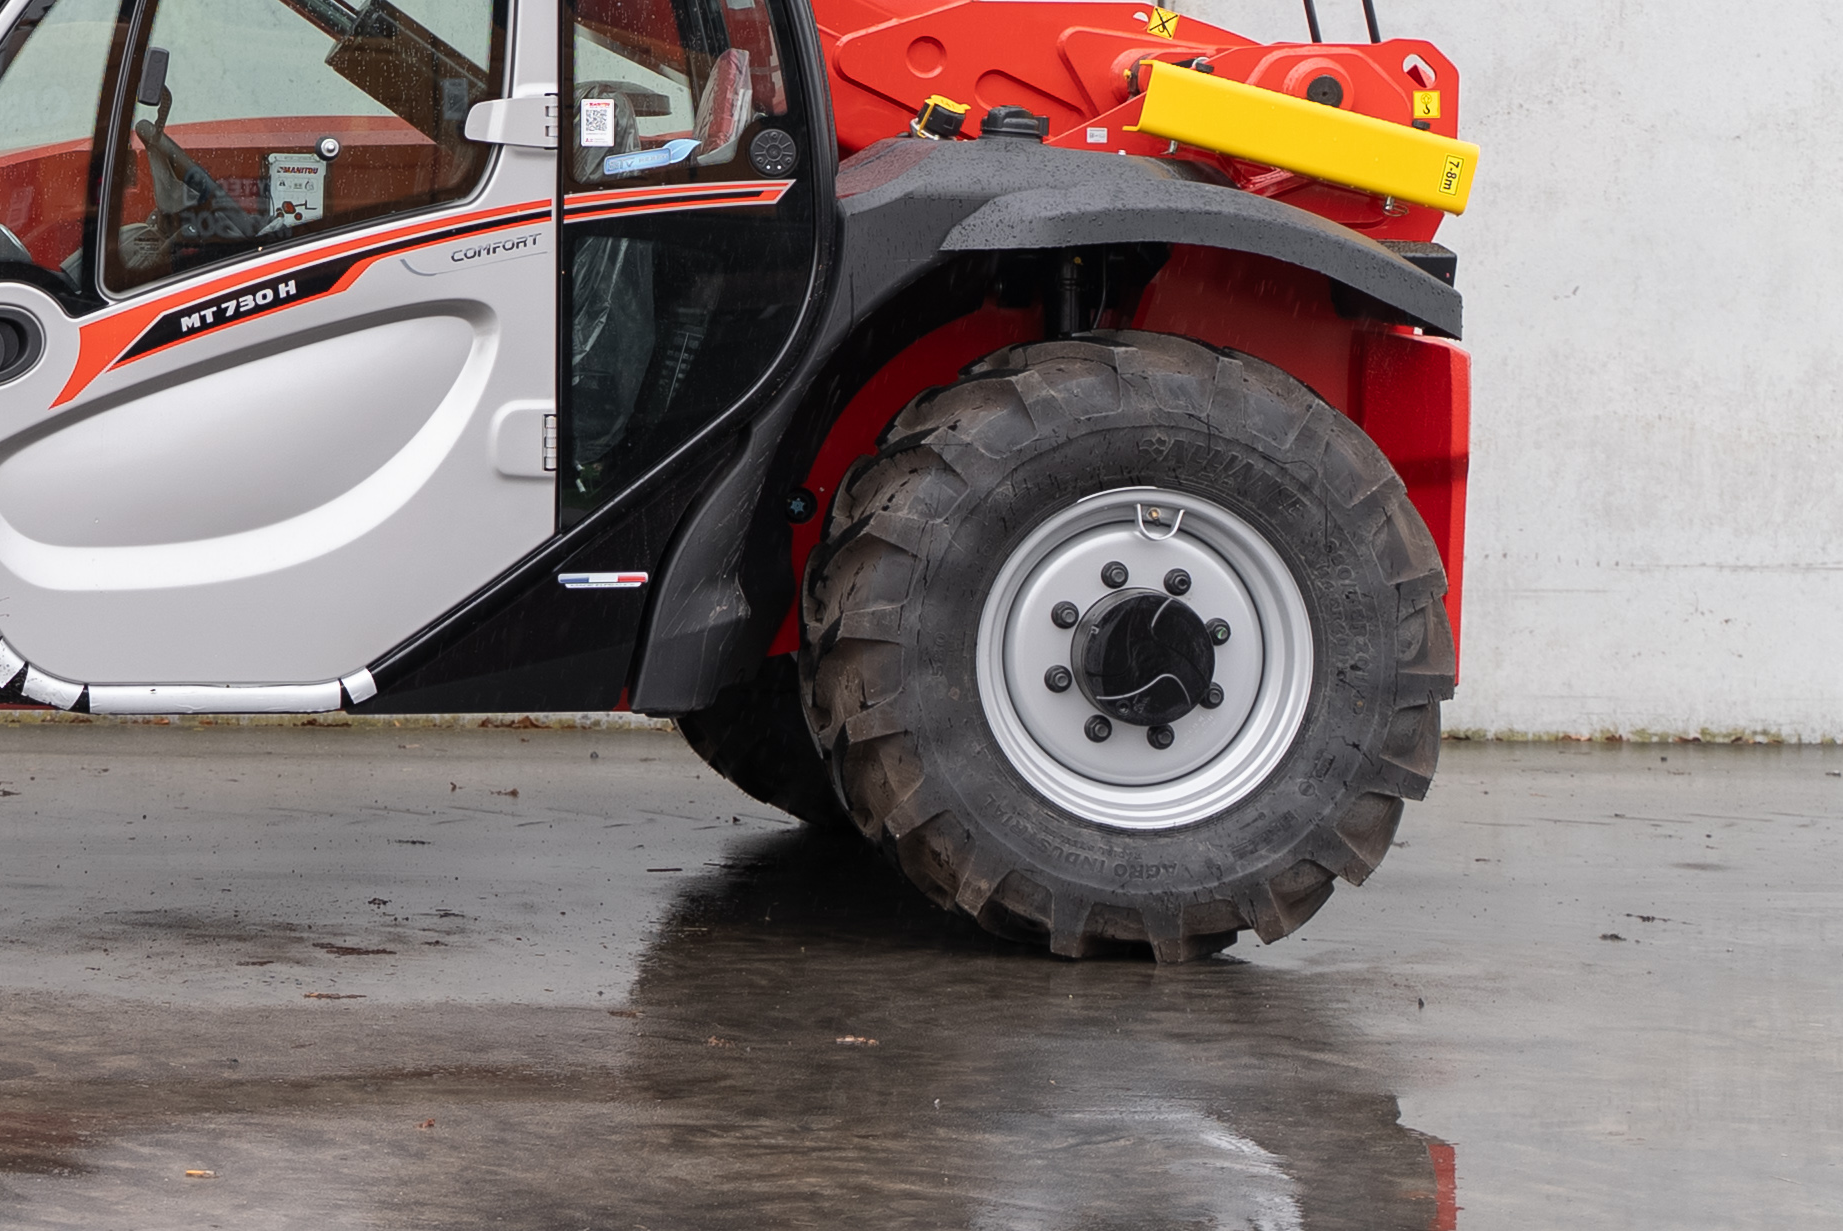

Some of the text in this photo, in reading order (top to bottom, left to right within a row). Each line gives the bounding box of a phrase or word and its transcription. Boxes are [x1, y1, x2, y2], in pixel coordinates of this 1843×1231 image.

[1443, 161, 1460, 190] 7-8m
[450, 232, 542, 262] COMFORT
[180, 279, 297, 333] MT 730 H
[1159, 436, 1308, 517] ALLIANCE
[977, 791, 1179, 878] AGRO INDUSTRIAL
